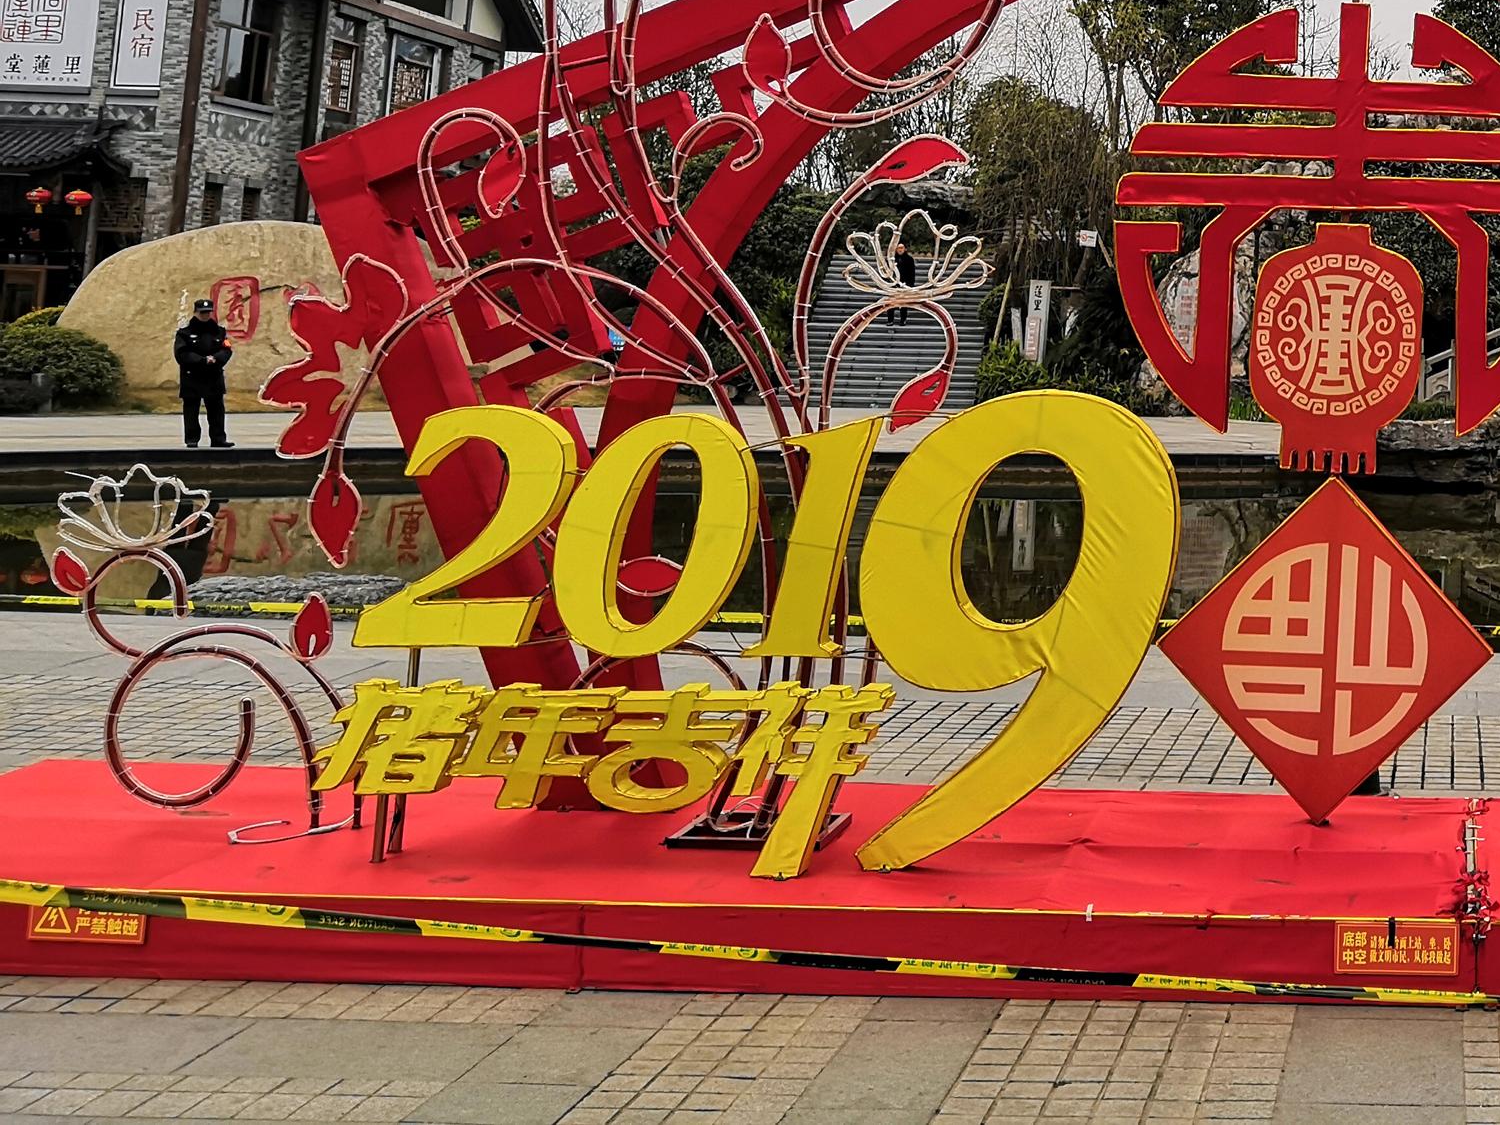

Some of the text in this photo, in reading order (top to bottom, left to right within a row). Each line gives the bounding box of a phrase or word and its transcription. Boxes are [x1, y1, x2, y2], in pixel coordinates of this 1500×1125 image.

[130, 9, 155, 59] 民宿
[352, 388, 1181, 872] 2019
[311, 678, 897, 879] 猪年吉祥
[75, 916, 139, 936] 严禁触碰
[1342, 931, 1367, 948] 底部
[1342, 950, 1367, 965] 中空
